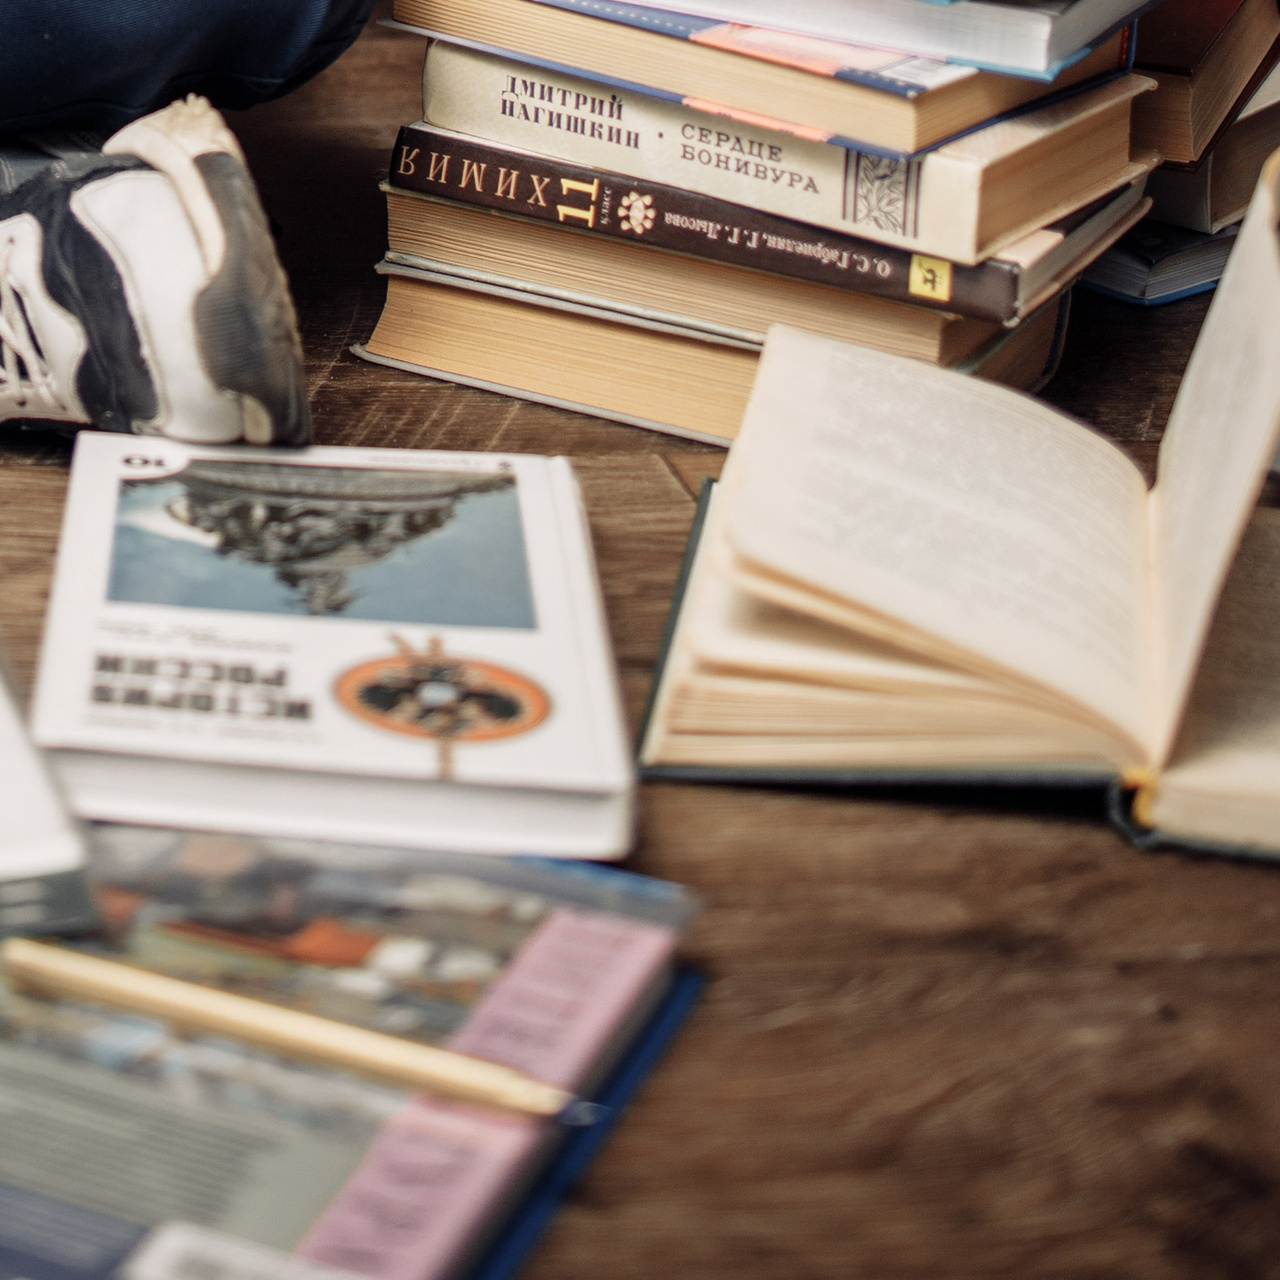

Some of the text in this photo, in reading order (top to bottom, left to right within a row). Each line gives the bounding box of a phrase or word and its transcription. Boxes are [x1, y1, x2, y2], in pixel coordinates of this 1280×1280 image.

[500, 96, 640, 150] НАГИШКИН
[501, 74, 624, 121] ДМИТРИЙ
[680, 122, 783, 163] СЕРДЦЕ
[397, 145, 551, 208] ХИМИЯ
[680, 143, 821, 194] БОНИВУРА
[556, 177, 600, 228] 11
[664, 211, 721, 240] Лысова
